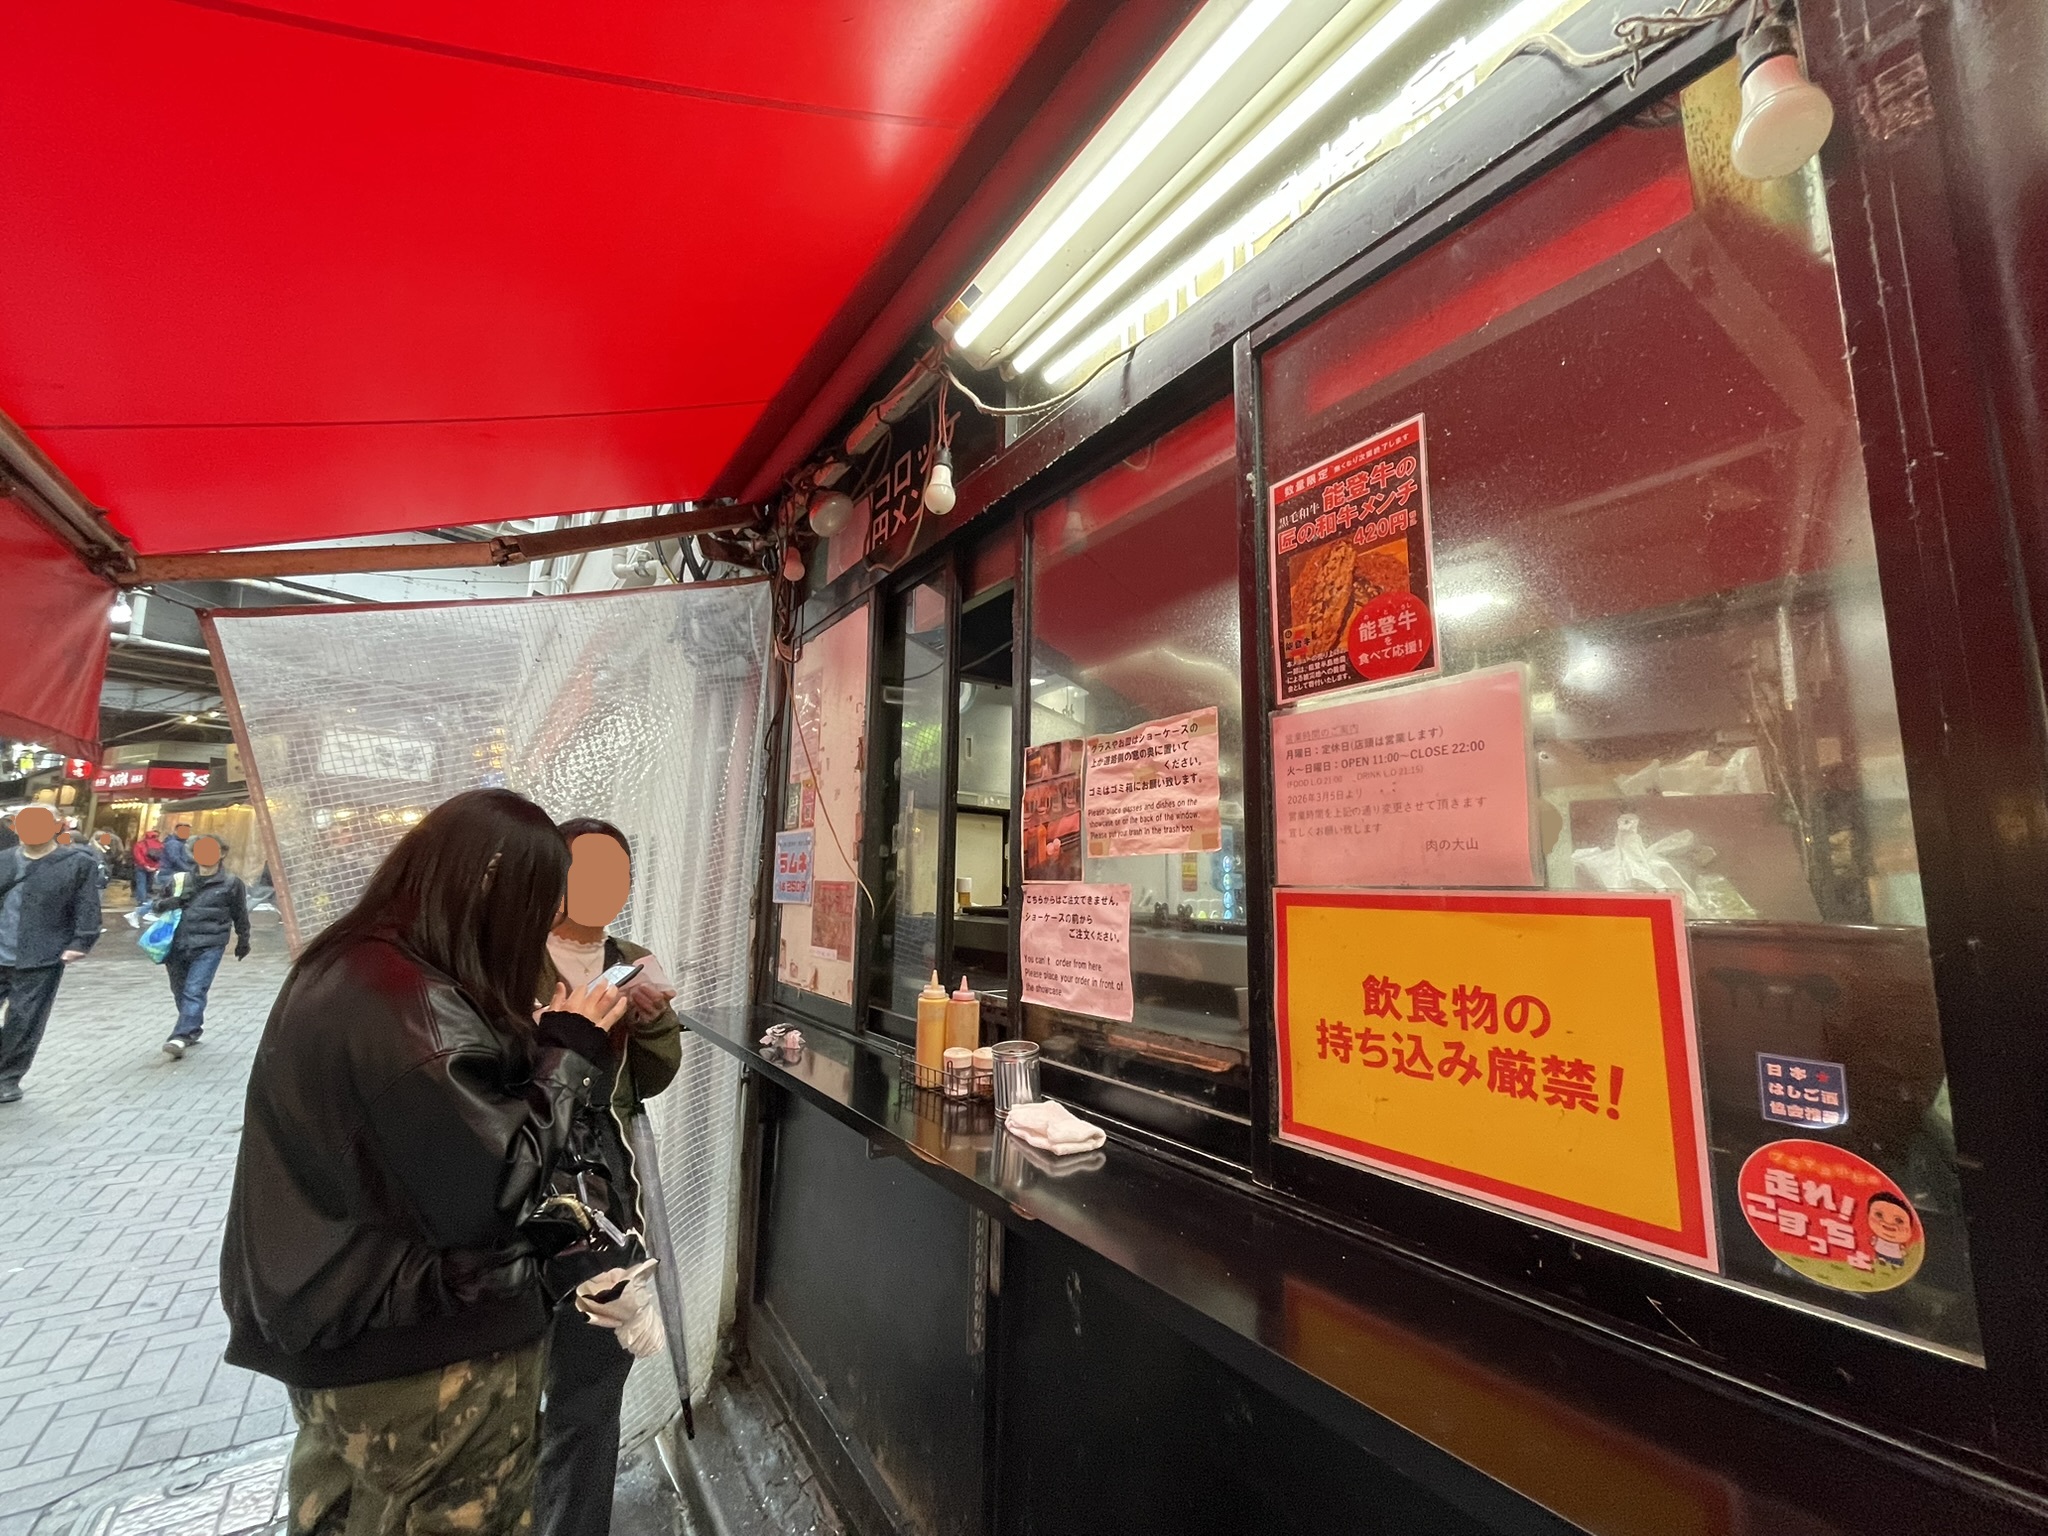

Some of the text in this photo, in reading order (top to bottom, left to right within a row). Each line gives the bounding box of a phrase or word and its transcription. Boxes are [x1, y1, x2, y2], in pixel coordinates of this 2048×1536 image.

[1284, 468, 1328, 497] 数量限定
[1322, 456, 1417, 512] 能登牛の
[1277, 479, 1418, 554] 匠の和牛メンチ
[1279, 502, 1320, 529] 黒毛和牛
[1354, 508, 1409, 545] 420円
[1358, 610, 1417, 642] 能登牛
[1384, 637, 1392, 645] を
[1358, 639, 1423, 666] 食べて応援!
[1452, 739, 1485, 755] 22:00
[1164, 757, 1202, 770] ください。
[1155, 799, 1176, 809] dishes
[1287, 787, 1362, 805] 2026年3月5日より
[1155, 812, 1163, 821] of
[1164, 812, 1174, 820] the
[1152, 825, 1161, 834] the
[1163, 824, 1180, 833] trash
[1425, 837, 1479, 852] 肉の大山
[779, 852, 807, 874] ラムネ
[1026, 895, 1118, 906] こちらからはご注文できません。
[1025, 912, 1093, 925] ショーケースの前から
[1069, 928, 1120, 942] ご注文ください。
[1024, 954, 1034, 964] You
[1055, 958, 1072, 967] order
[1073, 959, 1087, 969] from
[1060, 974, 1074, 983] your
[1075, 975, 1090, 986] order
[1092, 977, 1098, 987] in
[1099, 978, 1115, 990] front
[1116, 981, 1124, 991] of
[1362, 974, 1551, 1039] 飲食物の
[1315, 1018, 1625, 1121] 持ち込み厳禁!
[1766, 1063, 1807, 1080] 日本
[1764, 1168, 1855, 1221] 走れ!
